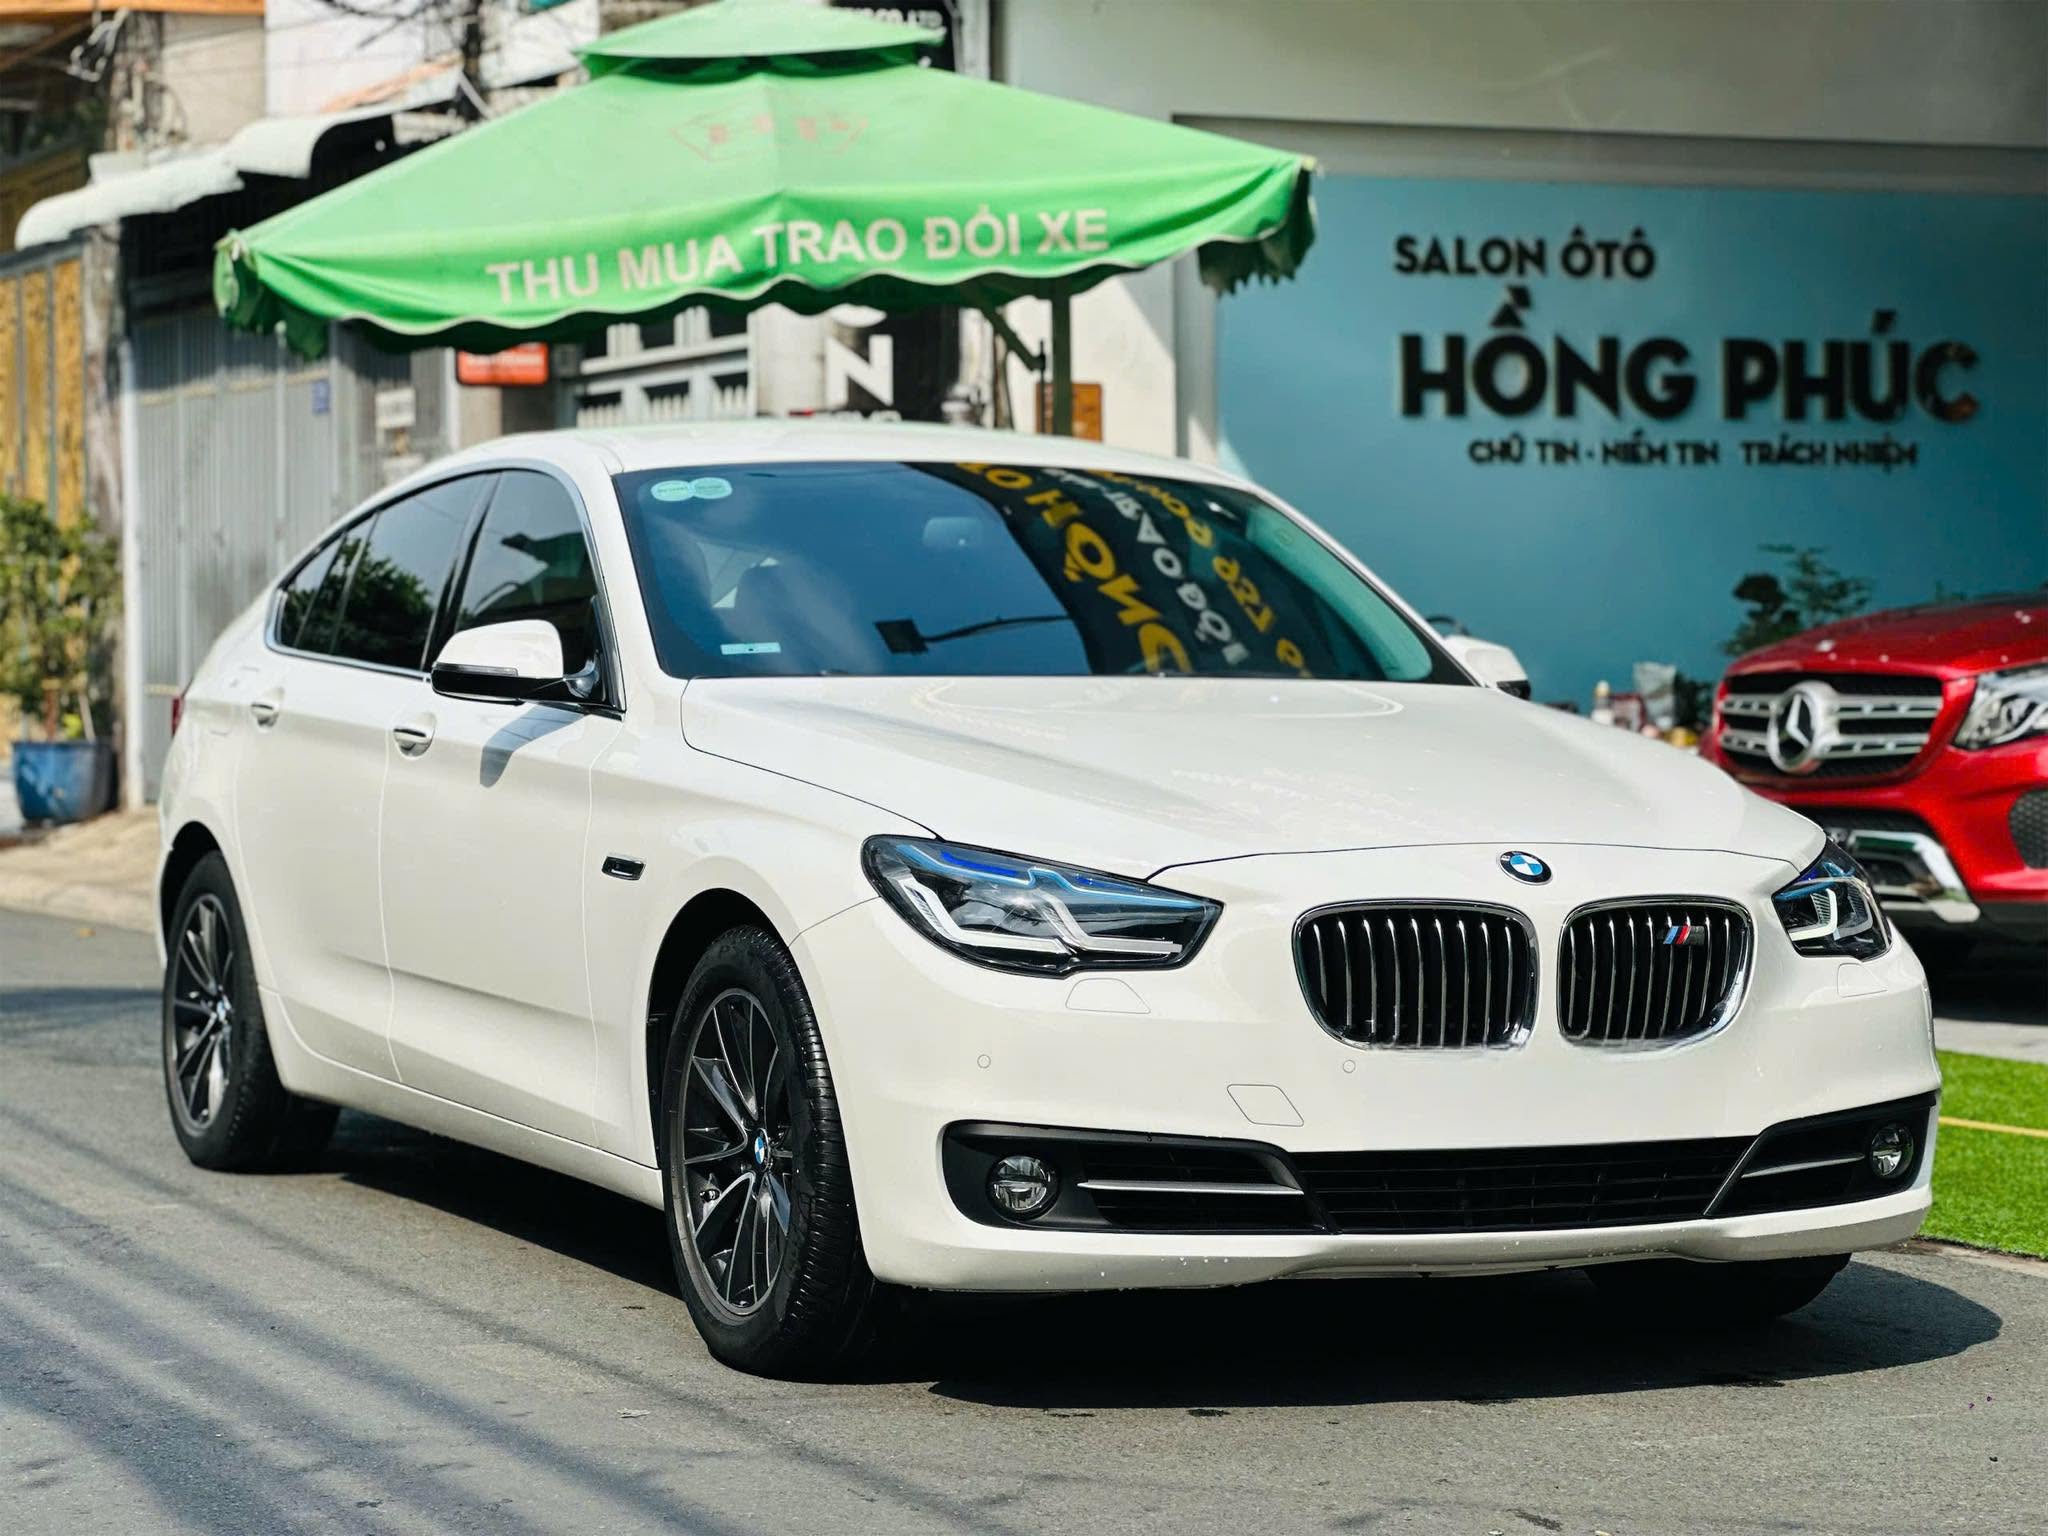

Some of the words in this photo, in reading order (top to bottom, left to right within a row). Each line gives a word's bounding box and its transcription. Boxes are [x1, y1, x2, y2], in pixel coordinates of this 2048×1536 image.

[485, 252, 599, 305] THU
[618, 234, 744, 290] MUA
[752, 217, 909, 268] TRAO
[1036, 208, 1109, 256] XE
[1395, 235, 1547, 274] SALON
[1561, 225, 1656, 279] ÔTÔ
[1401, 284, 1698, 421] HỒNG
[1724, 309, 1980, 423] PHÚC
